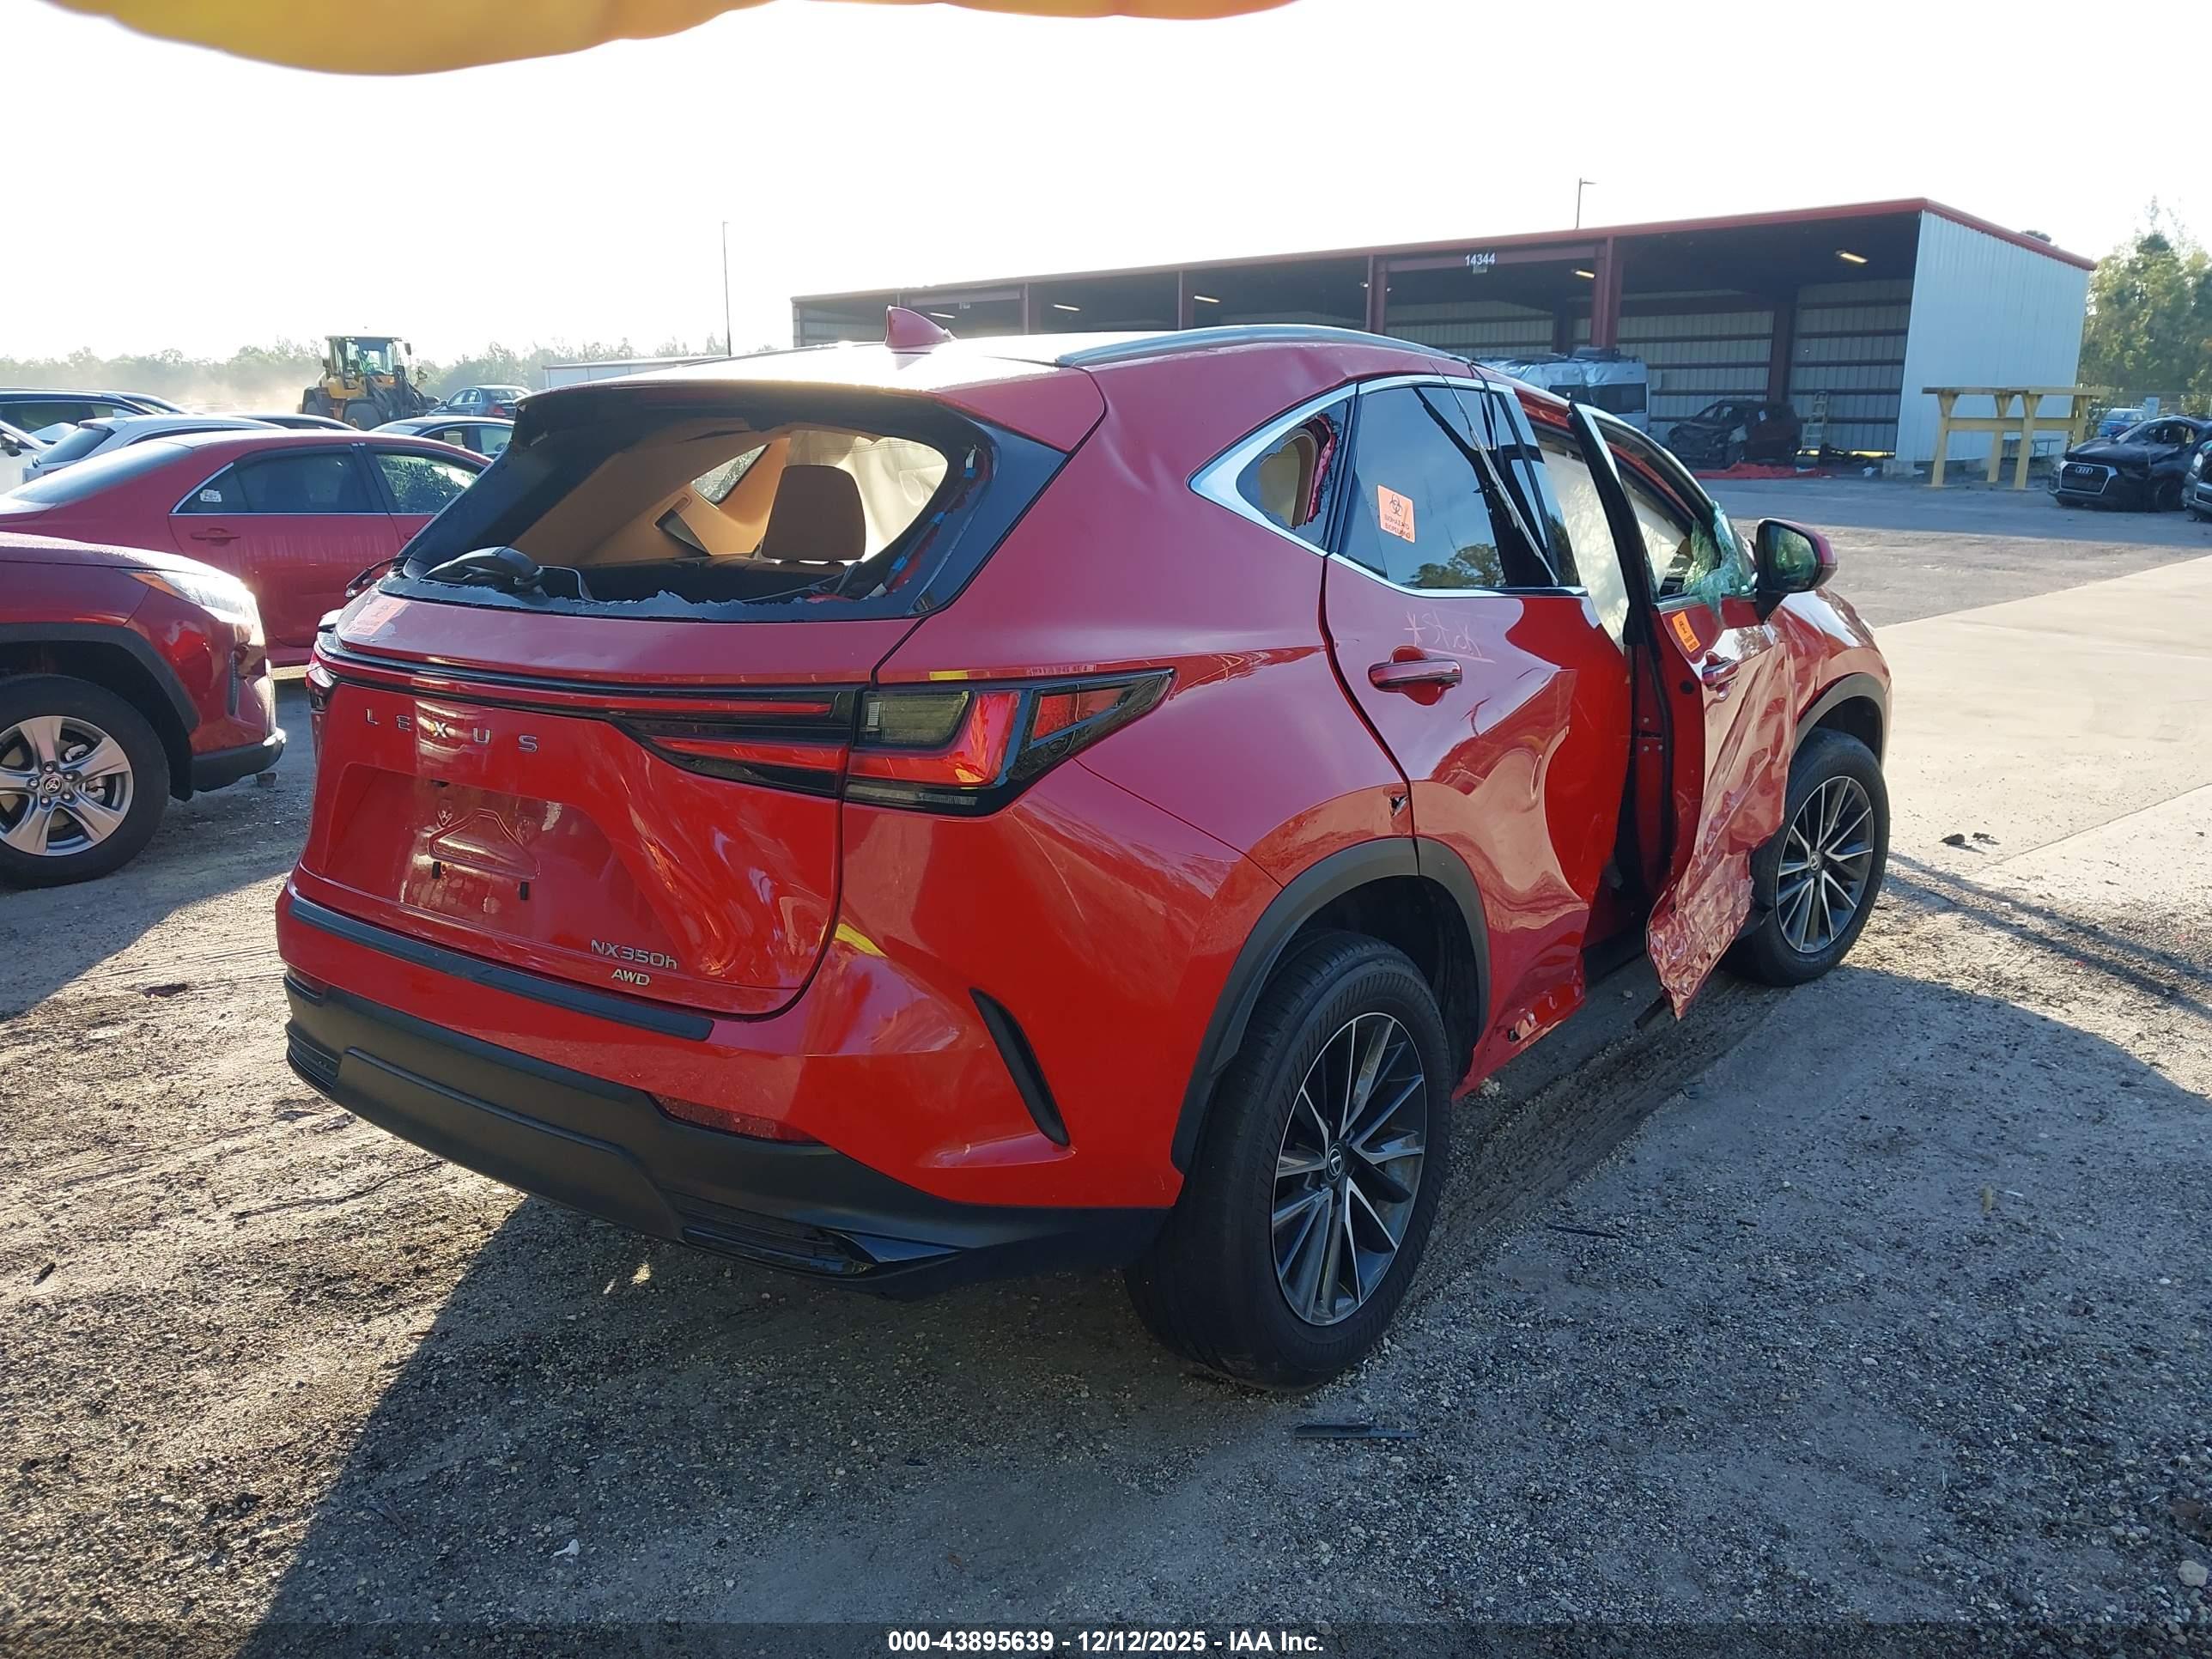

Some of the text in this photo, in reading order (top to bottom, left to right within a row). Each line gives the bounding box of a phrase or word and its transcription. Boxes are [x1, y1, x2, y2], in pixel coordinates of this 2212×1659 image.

[1465, 252, 1496, 267] 14344
[365, 708, 539, 753] LEXUS
[590, 939, 678, 969] NX350h
[611, 968, 651, 986] AWD
